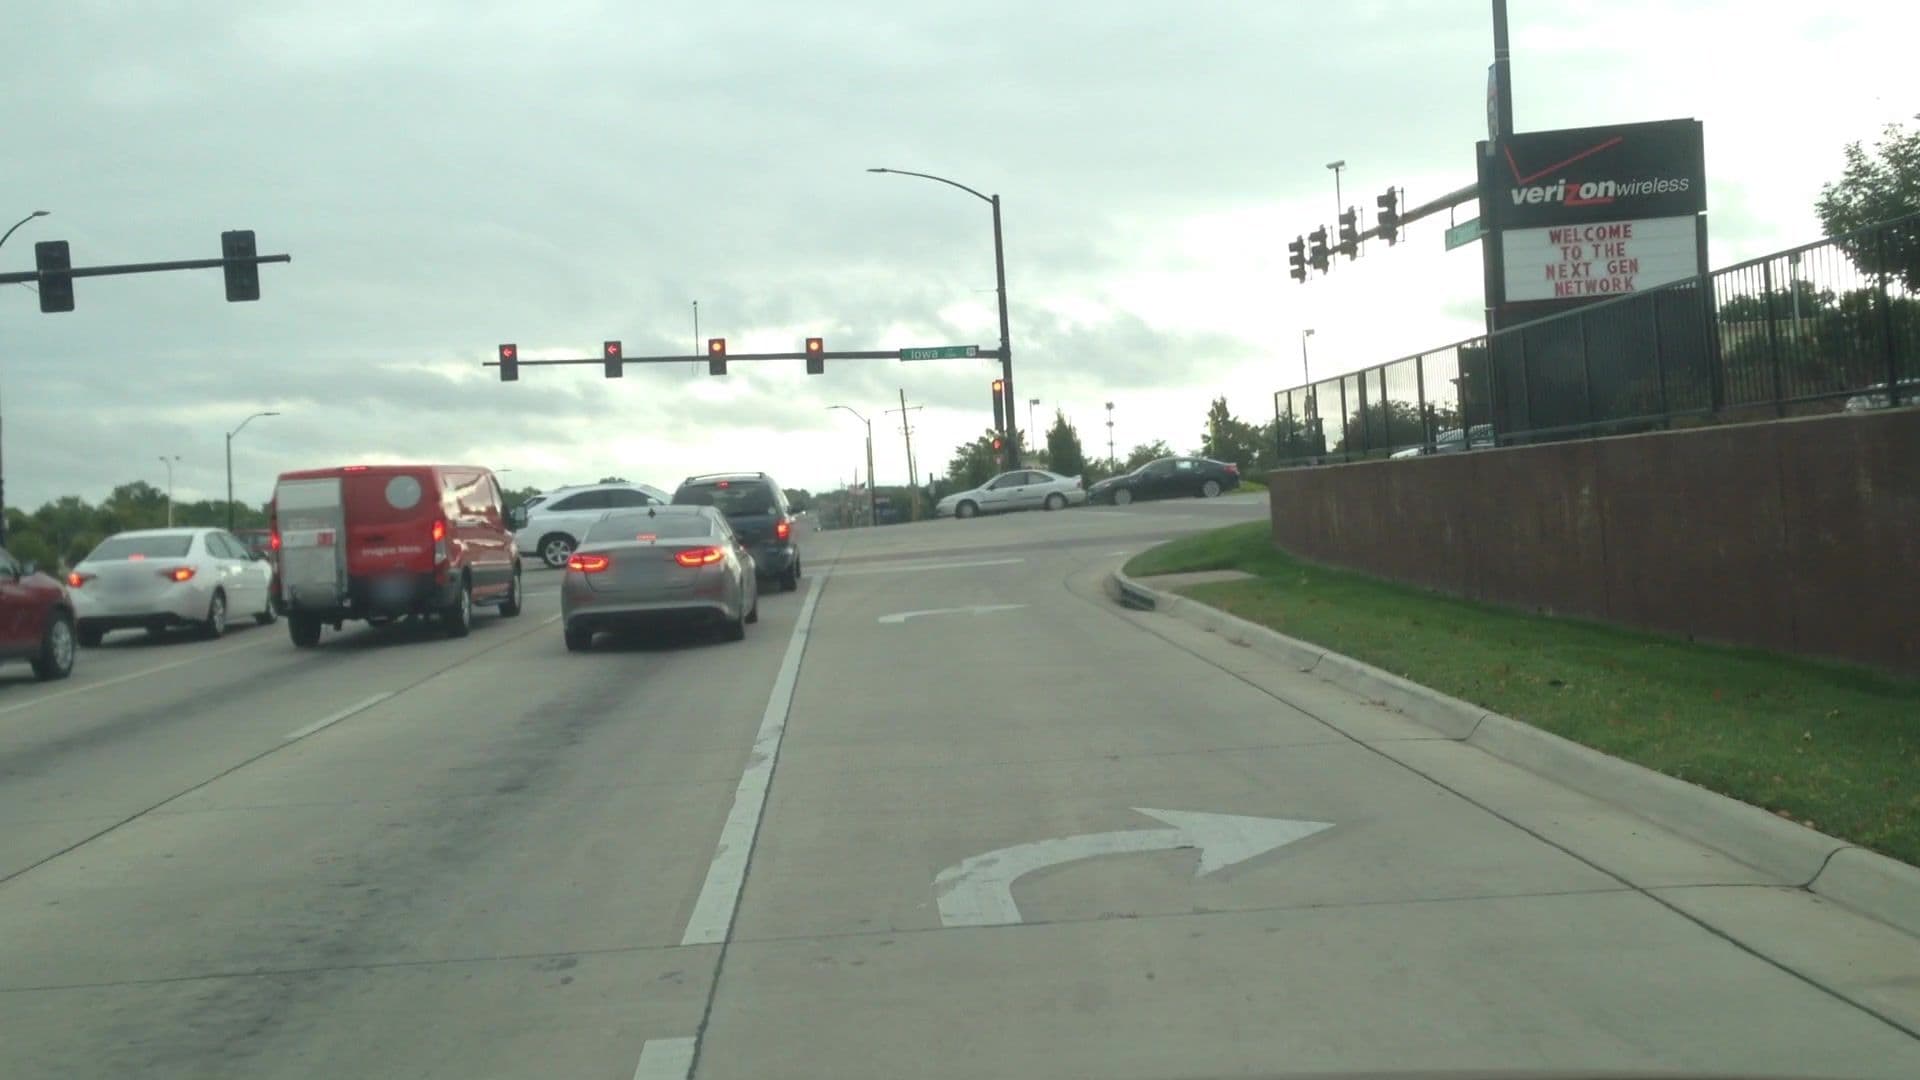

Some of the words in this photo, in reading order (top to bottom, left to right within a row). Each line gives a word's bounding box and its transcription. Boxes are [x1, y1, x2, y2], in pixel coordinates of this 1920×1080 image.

[1511, 179, 1615, 206] verizon
[1616, 176, 1689, 196] wireless
[1549, 224, 1632, 244] WELCOME
[1561, 245, 1582, 260] TO
[1592, 243, 1625, 258] THE
[1546, 262, 1592, 279] NEXT
[1607, 259, 1639, 275] GEN
[1555, 276, 1635, 297] NETWORK
[911, 350, 938, 359] Iowa
